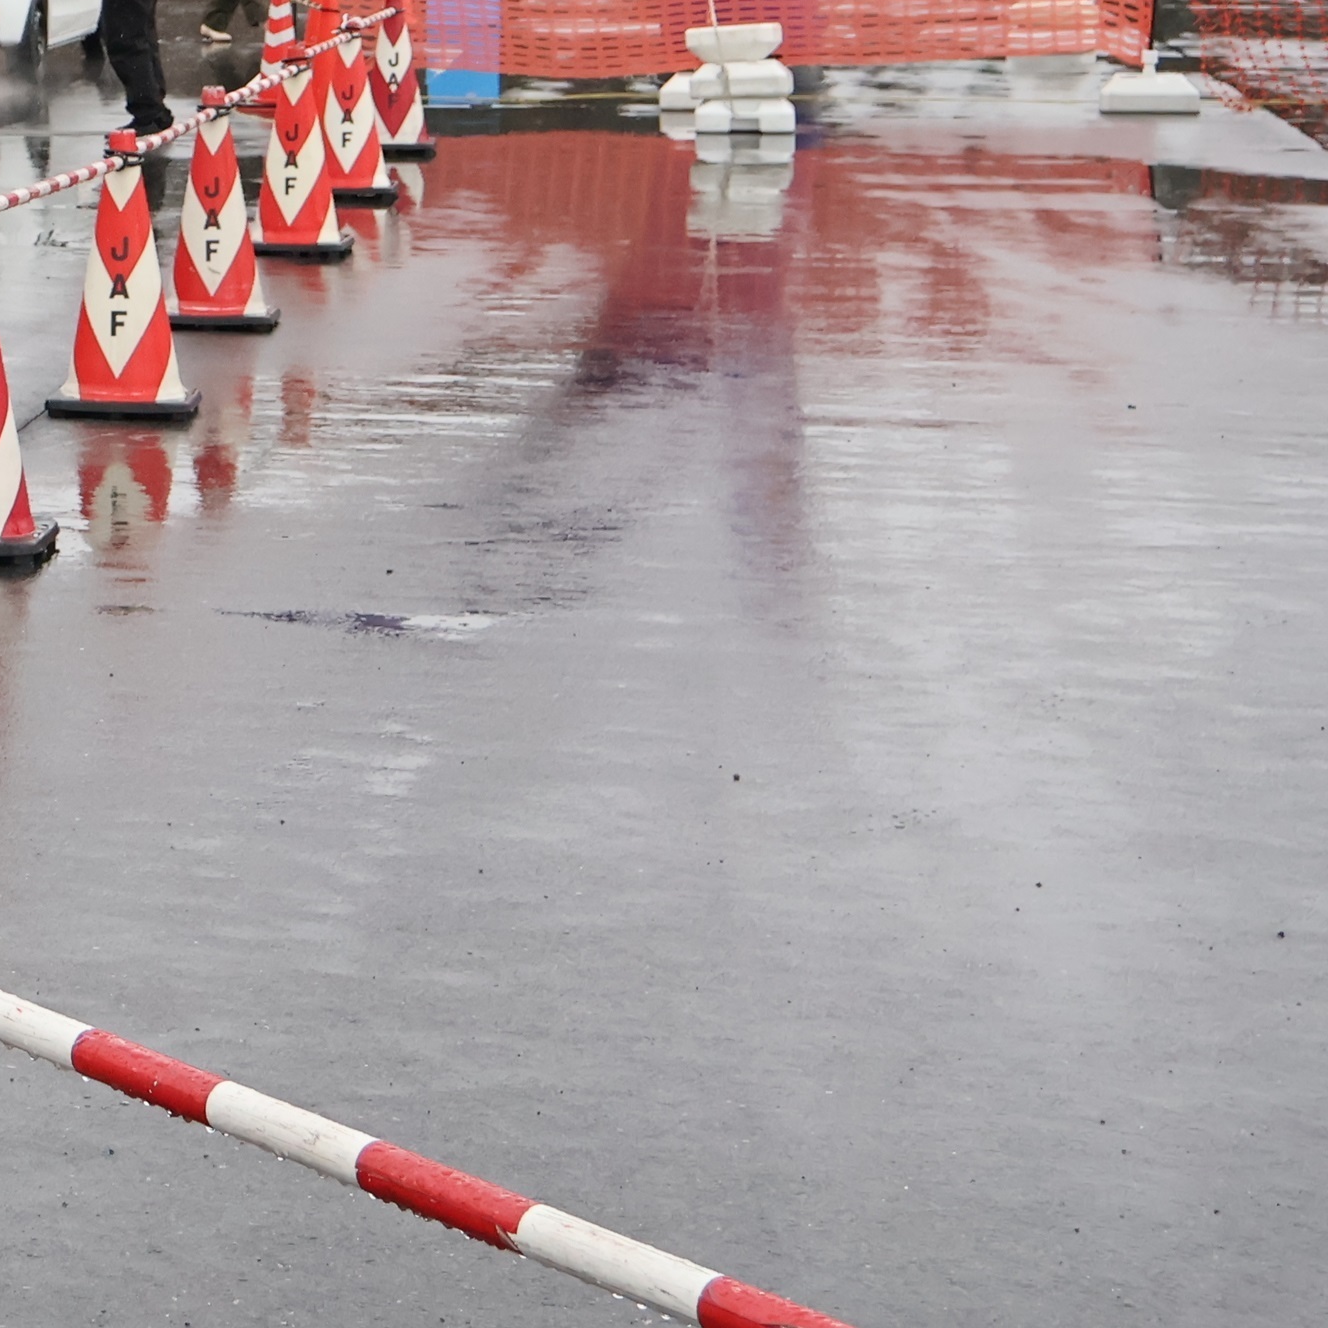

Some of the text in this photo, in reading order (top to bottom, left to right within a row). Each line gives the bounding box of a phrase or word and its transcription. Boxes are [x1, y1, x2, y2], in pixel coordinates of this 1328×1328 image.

[341, 84, 353, 149] JAF
[284, 122, 300, 196] JAF
[203, 176, 222, 262] JAF
[108, 237, 130, 337] JAF
